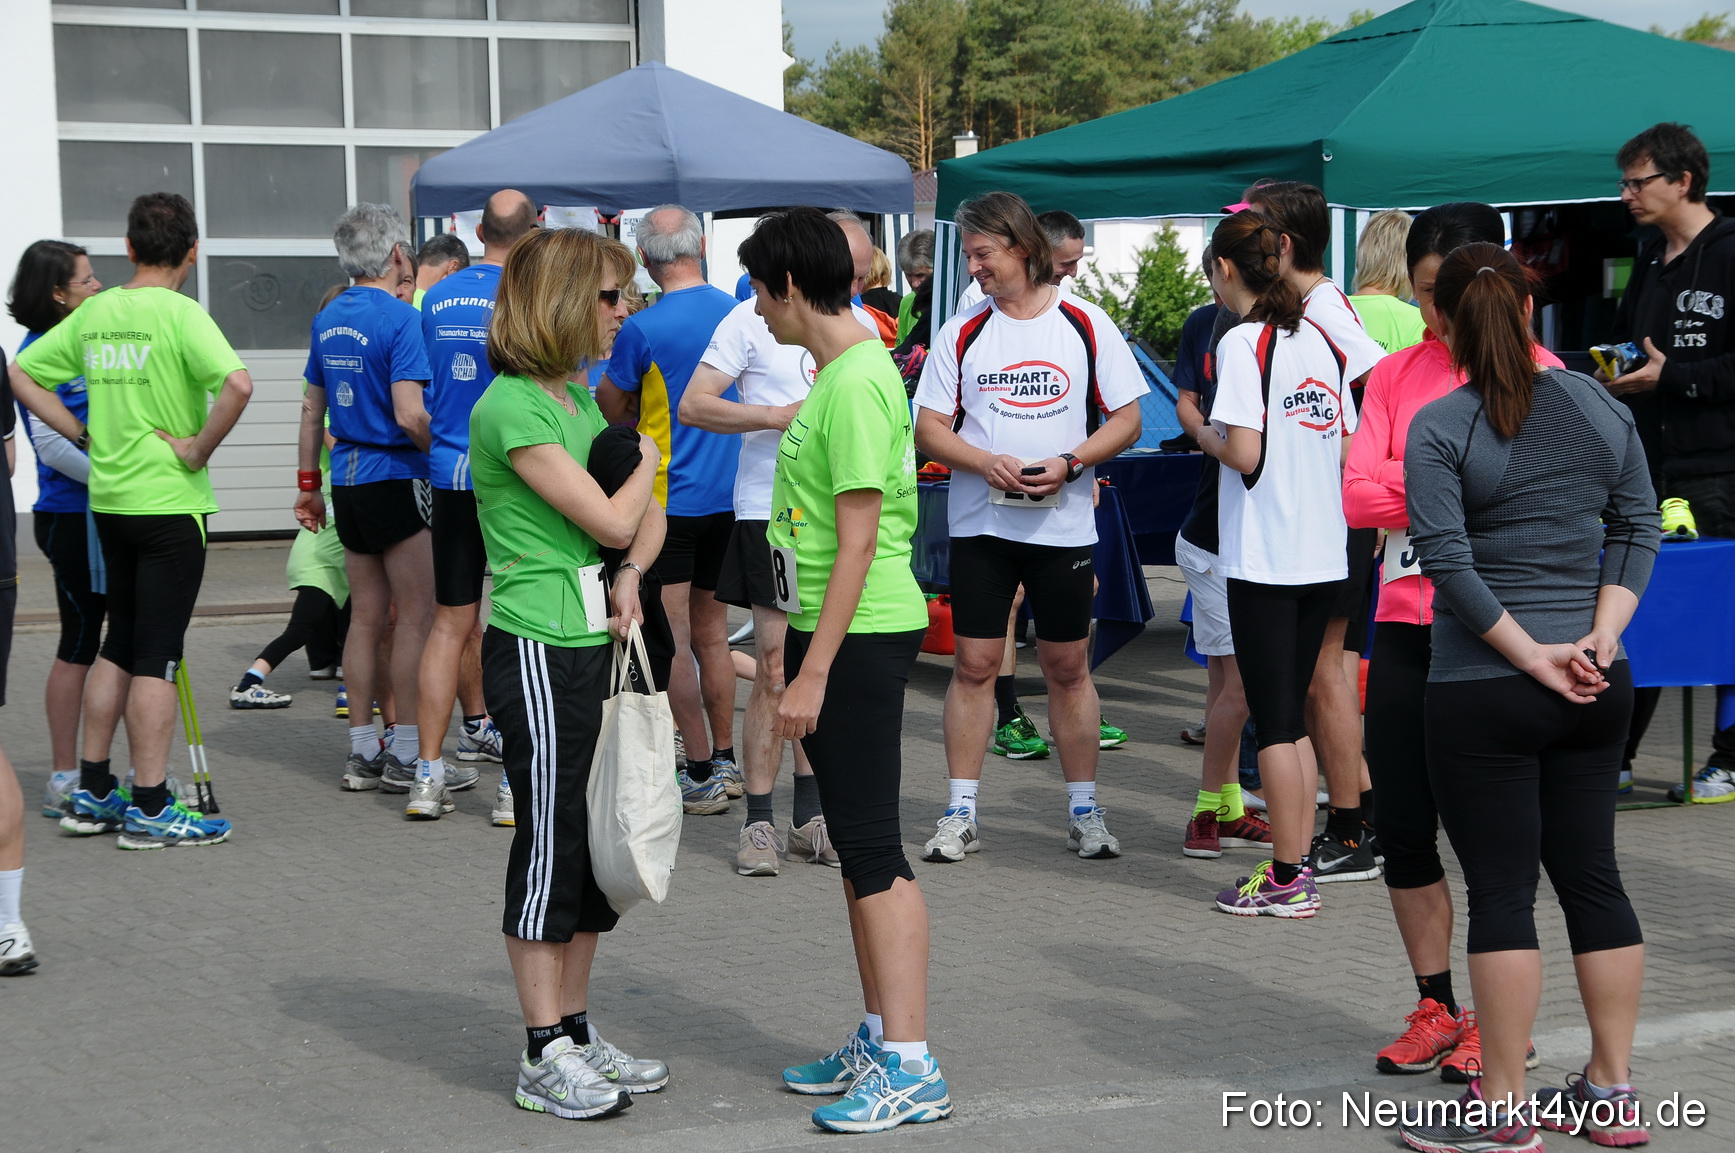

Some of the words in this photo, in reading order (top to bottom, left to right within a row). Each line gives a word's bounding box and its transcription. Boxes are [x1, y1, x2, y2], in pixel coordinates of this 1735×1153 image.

[431, 297, 495, 315] funrunne
[319, 326, 369, 346] funrunners
[438, 328, 469, 337] Neumarkter
[469, 329, 489, 339] Tagbla
[1673, 333, 1708, 348] RTS
[101, 343, 152, 370] DAV
[977, 371, 1051, 385] GERHART
[979, 385, 1012, 393] Autohaus
[1010, 384, 1061, 397] JÄNIG
[988, 402, 1000, 414] Das
[999, 410, 1035, 421] sportliche
[1036, 404, 1069, 420] Autohaus
[896, 485, 916, 499] Sektio
[773, 549, 790, 603] 8
[532, 1028, 552, 1039] TECH
